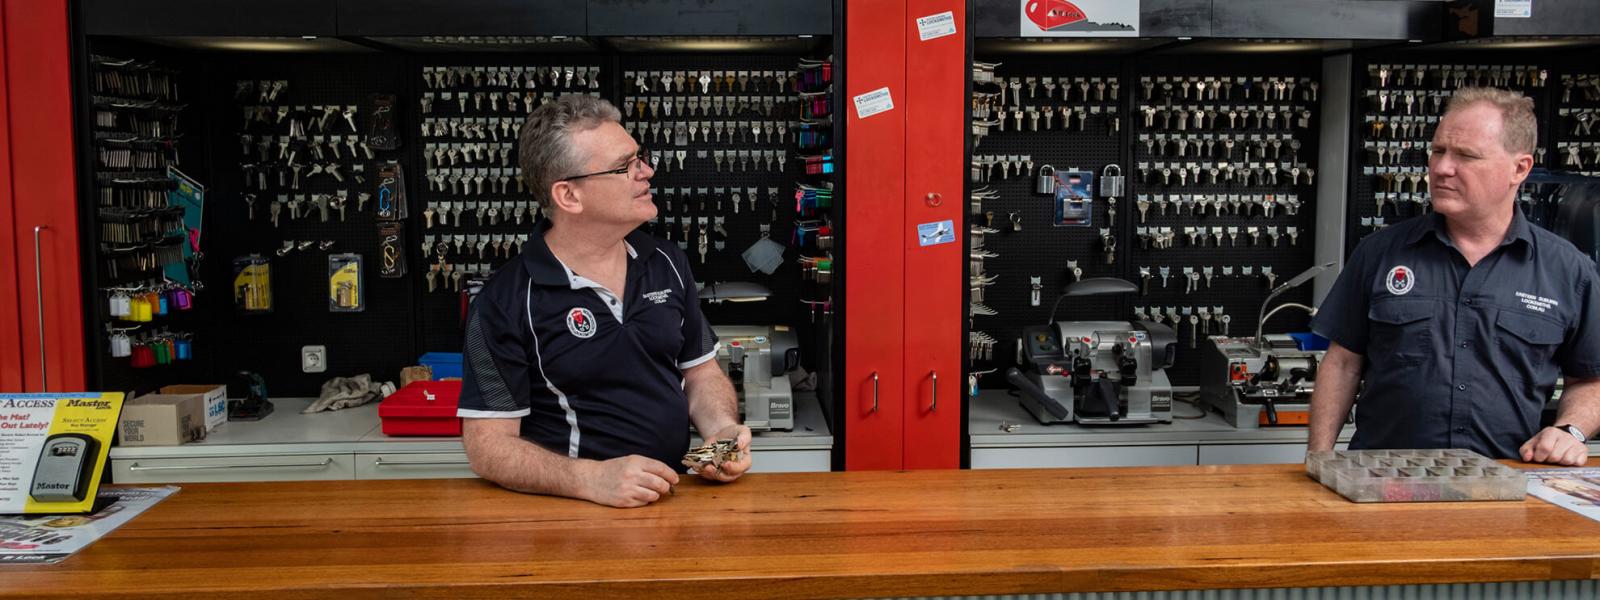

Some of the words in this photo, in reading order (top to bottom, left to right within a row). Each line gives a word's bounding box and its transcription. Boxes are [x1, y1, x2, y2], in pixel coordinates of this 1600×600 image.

[3, 398, 55, 408] ACCESS
[65, 399, 111, 407] Master
[19, 422, 49, 430] Lately?
[123, 420, 144, 428] SECURE
[36, 481, 71, 490] Master
